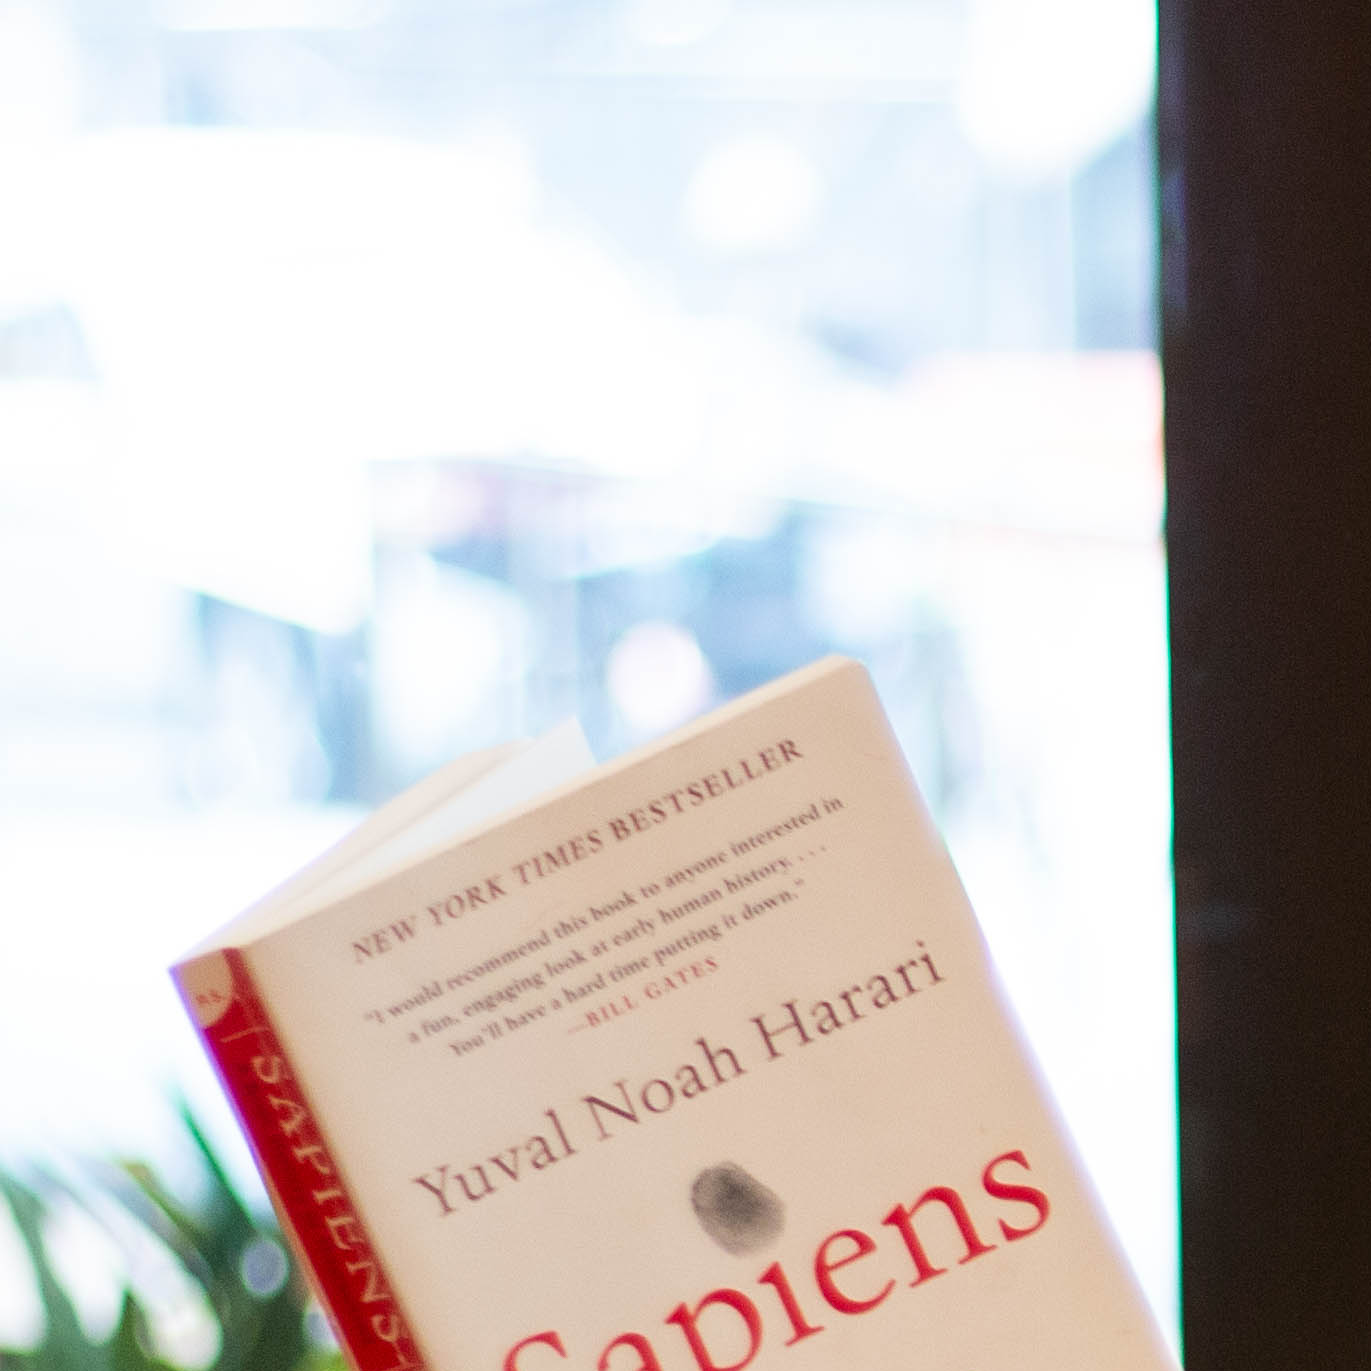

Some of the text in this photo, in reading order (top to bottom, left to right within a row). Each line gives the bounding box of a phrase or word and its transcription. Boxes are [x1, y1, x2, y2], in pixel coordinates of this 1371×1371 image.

[351, 738, 804, 964] NEW YORK TIMES BESTSELLER
[387, 981, 444, 1018] would
[447, 929, 551, 991] recommend
[553, 920, 589, 940] this
[589, 889, 639, 923] book
[639, 882, 662, 899] to
[664, 849, 729, 888] anyone
[729, 803, 822, 857] interested
[821, 797, 845, 815] in
[408, 1031, 421, 1045] a
[462, 972, 547, 1018] engaging
[544, 948, 589, 977] look
[590, 939, 610, 958] at
[611, 917, 656, 948] early
[656, 888, 724, 926] human
[502, 1003, 548, 1032] have
[551, 997, 563, 1011] a
[560, 973, 607, 1004] hard
[608, 955, 651, 983] time
[653, 922, 723, 967] putting
[720, 913, 739, 930] it
[643, 955, 720, 1001] GATES
[411, 939, 947, 1217] Yuval Noah Harari
[250, 1053, 404, 1346] SAPIENS
